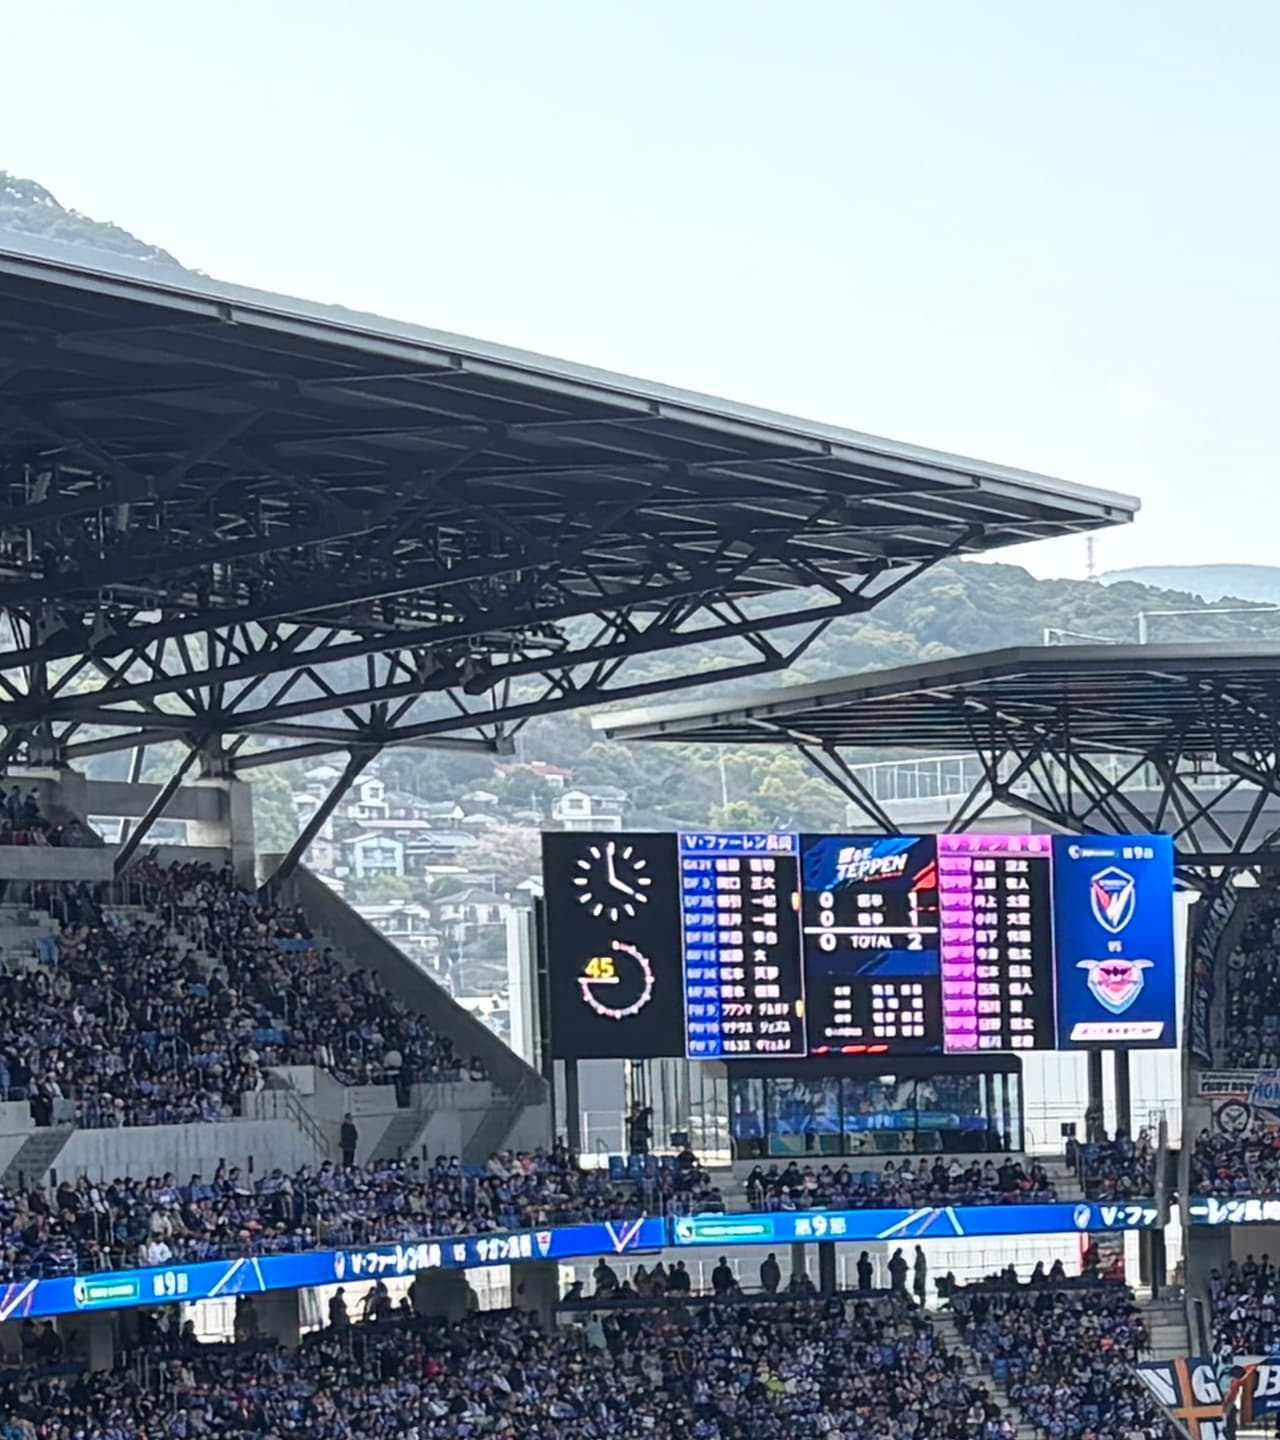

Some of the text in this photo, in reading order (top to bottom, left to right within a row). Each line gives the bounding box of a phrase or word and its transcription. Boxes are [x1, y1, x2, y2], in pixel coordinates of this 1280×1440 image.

[837, 853, 908, 879] TEPPEN
[819, 891, 834, 908] 0
[908, 892, 918, 908] 1
[820, 910, 835, 927] 0
[909, 910, 918, 926] 1
[819, 933, 837, 951] 0
[851, 935, 893, 949] TOTAL
[907, 934, 923, 950] 2
[584, 958, 616, 976] 45
[1192, 1365, 1222, 1404] G
